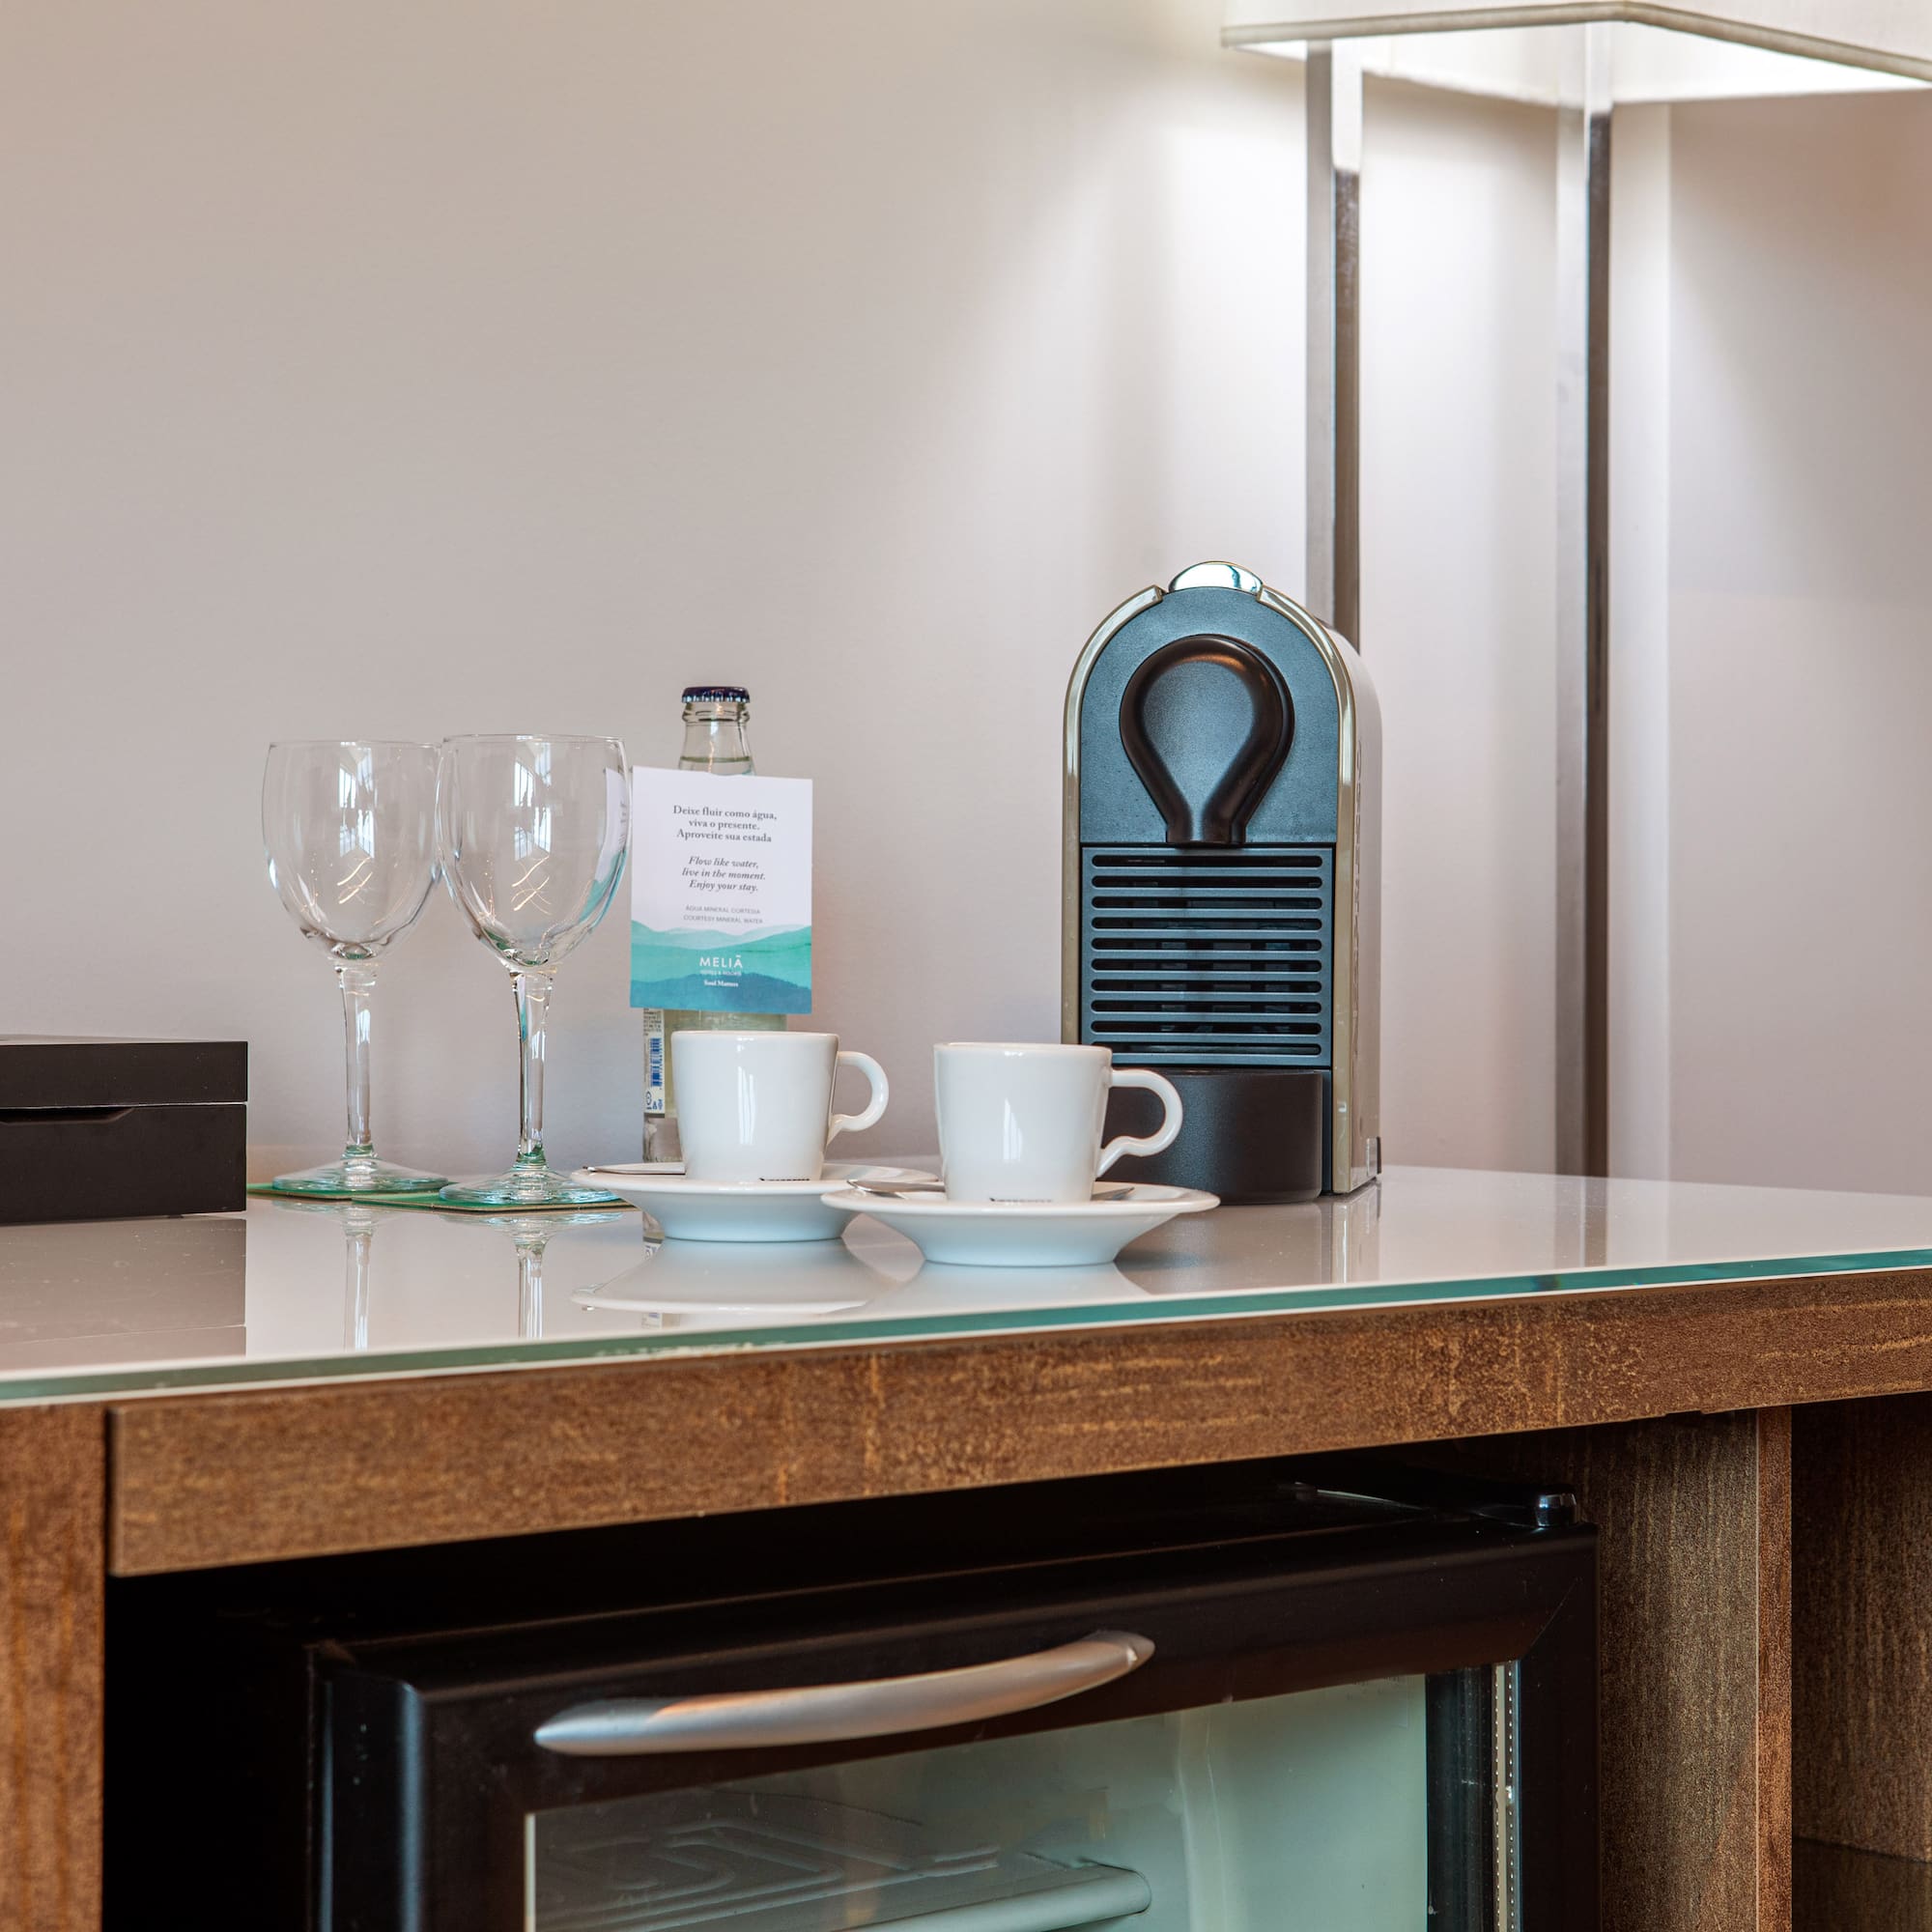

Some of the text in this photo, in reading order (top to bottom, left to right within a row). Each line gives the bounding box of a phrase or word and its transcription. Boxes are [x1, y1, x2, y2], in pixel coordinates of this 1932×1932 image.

[673, 805, 777, 821] Deixe fluir como água,
[688, 819, 708, 828] viva
[718, 821, 760, 832] presente.
[676, 828, 724, 840] Aproveite
[742, 834, 772, 842] estada
[688, 856, 759, 869] Flow like water,
[682, 867, 700, 876] live
[712, 868, 726, 878] the
[728, 870, 766, 880] moment.
[689, 879, 758, 894] Enjoy your stay.
